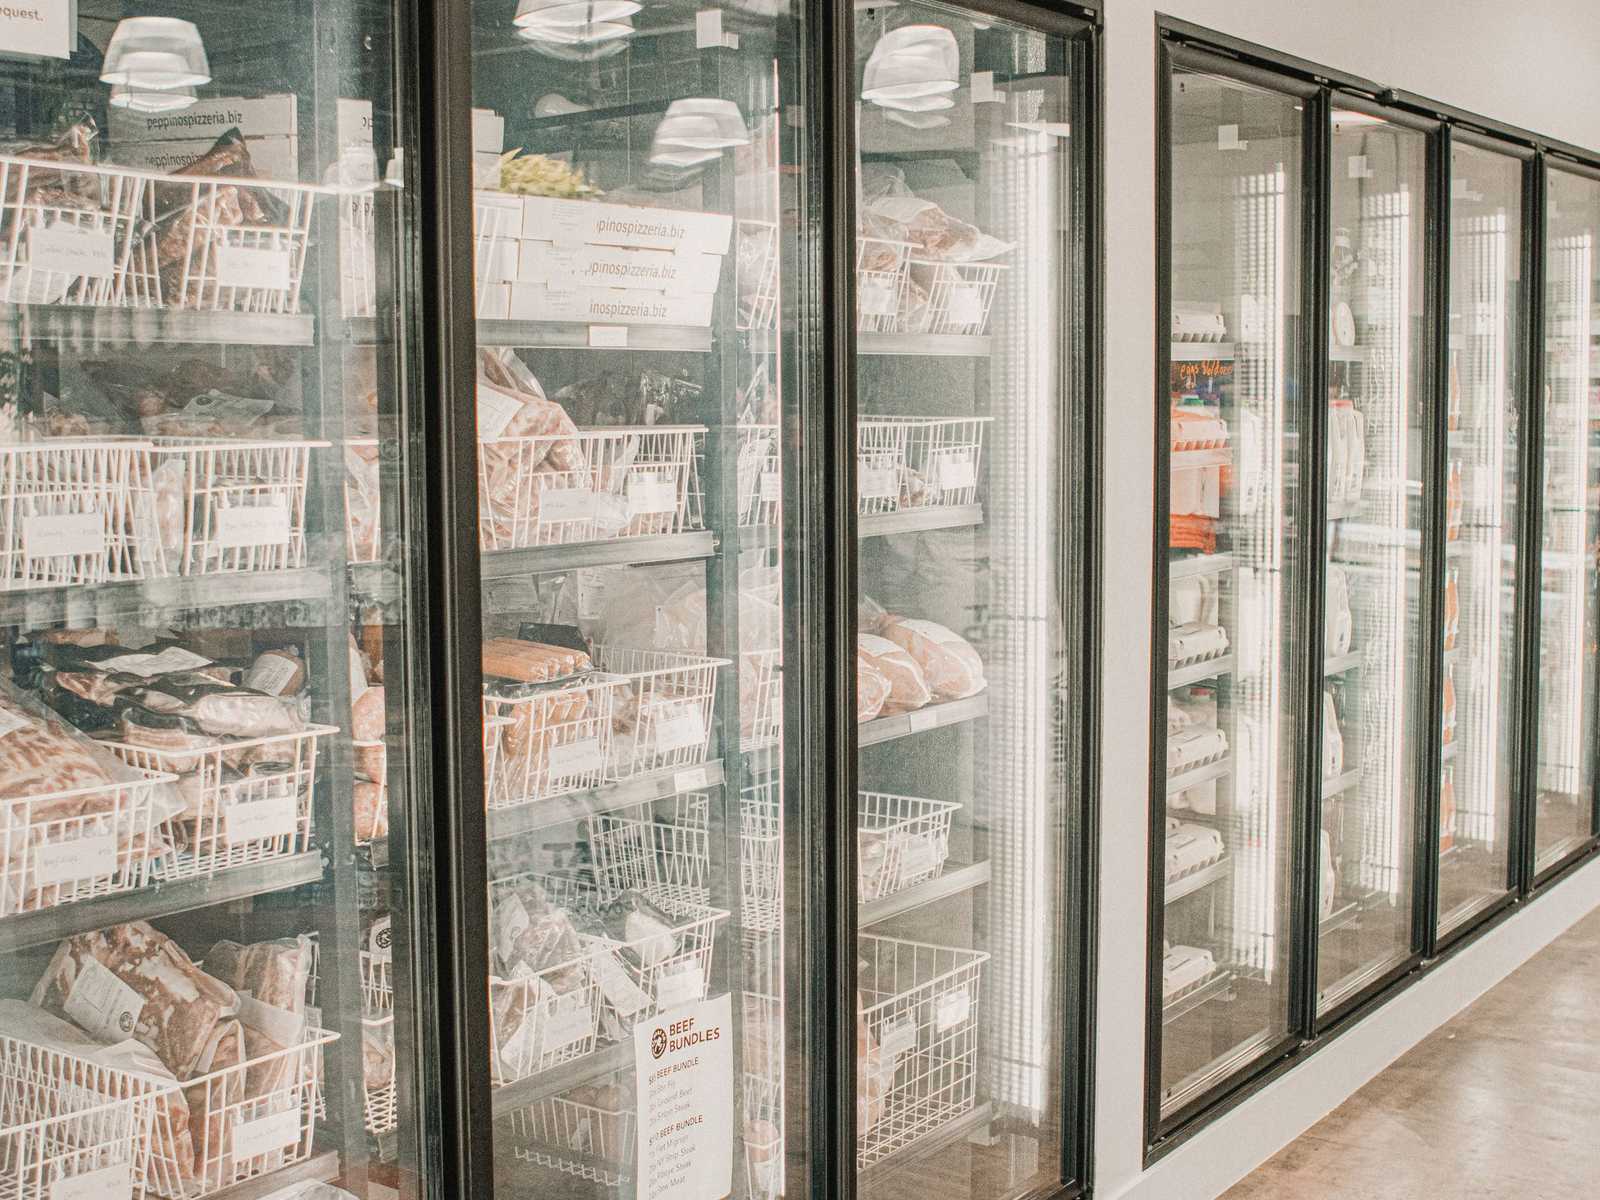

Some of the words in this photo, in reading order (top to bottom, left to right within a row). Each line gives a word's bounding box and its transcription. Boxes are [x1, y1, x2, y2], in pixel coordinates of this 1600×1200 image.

[0, 7, 44, 21] quest.
[146, 110, 243, 129] peppinospizzeria.biz
[669, 1018, 694, 1036] BEEF
[669, 1027, 720, 1052] BUNDLES
[656, 1066, 672, 1079] BEEF
[673, 1056, 699, 1072] BUNDLE
[660, 1124, 674, 1138] BEEF
[676, 1114, 703, 1131] BUNDLE
